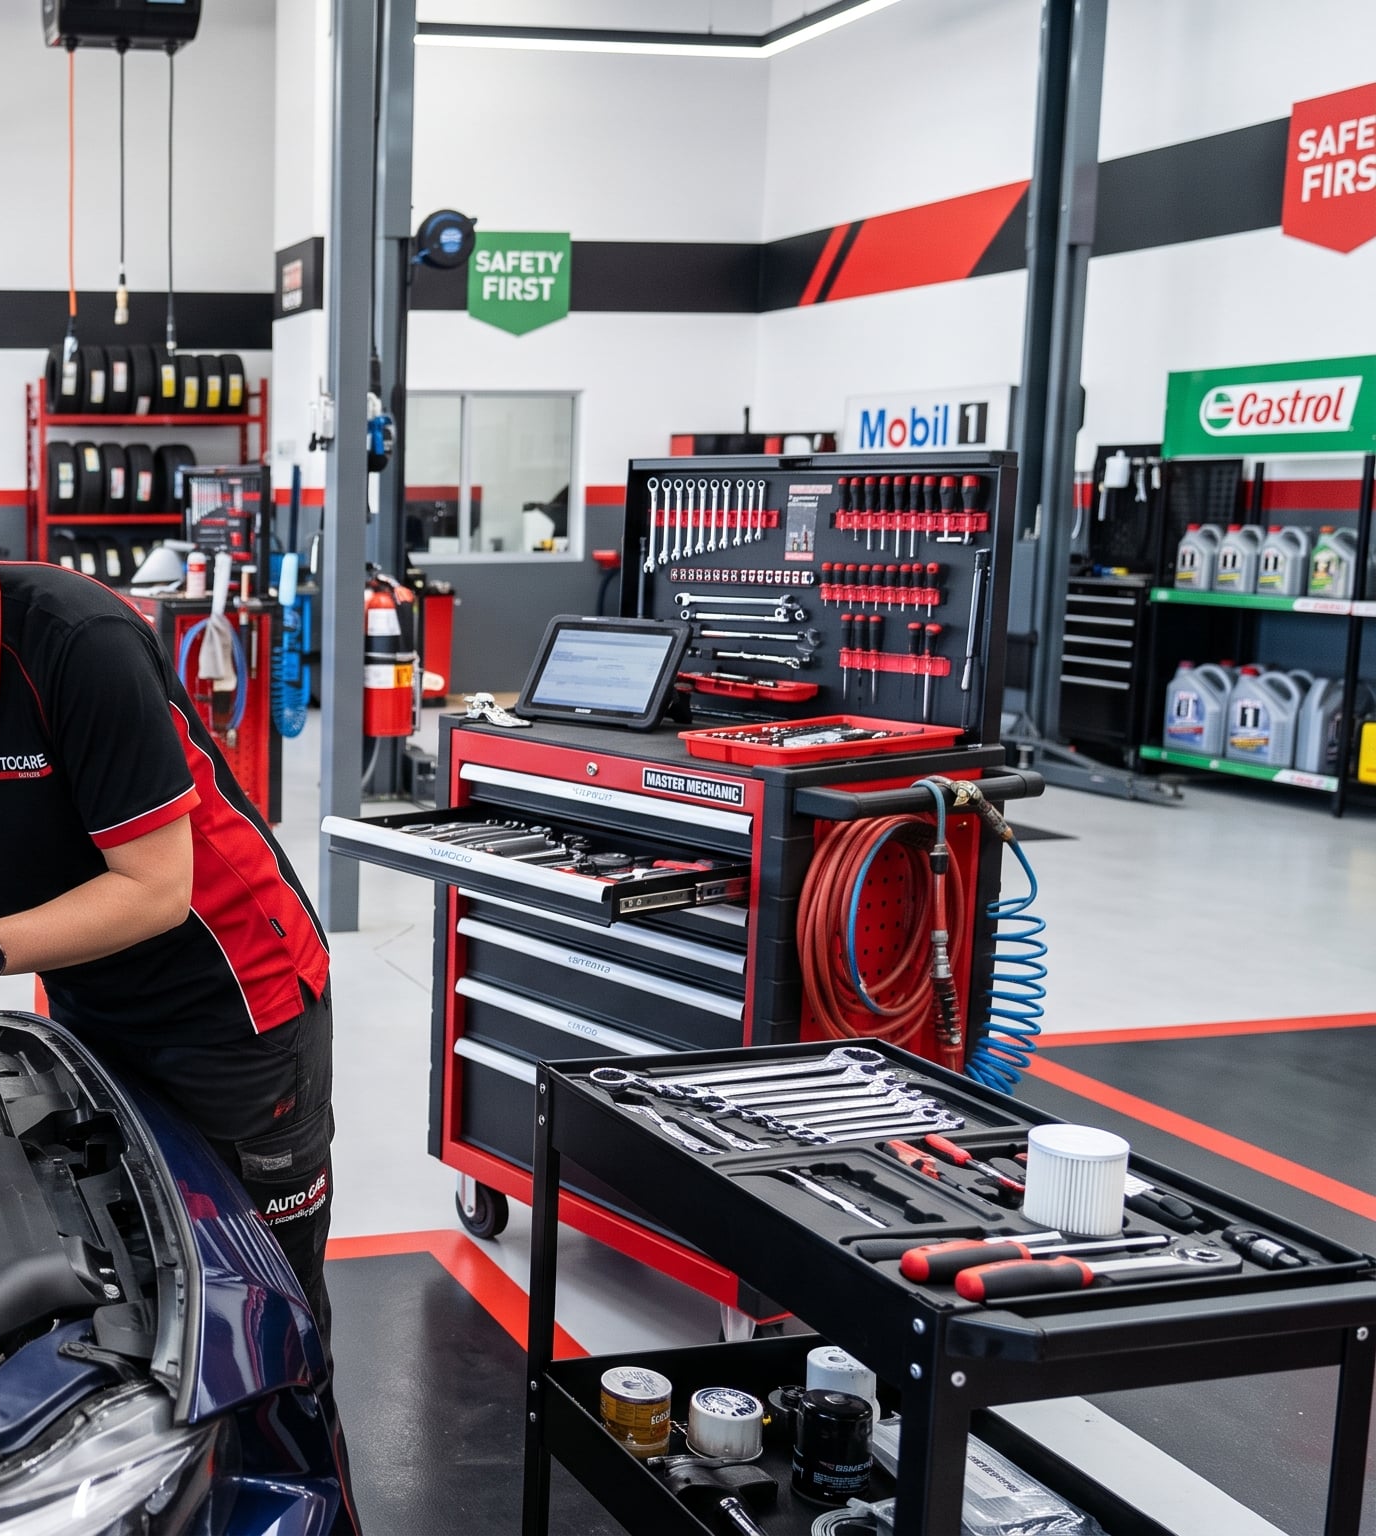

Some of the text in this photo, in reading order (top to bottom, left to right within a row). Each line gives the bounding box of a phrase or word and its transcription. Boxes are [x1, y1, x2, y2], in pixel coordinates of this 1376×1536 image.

[1297, 114, 1376, 162] SAFE
[1301, 154, 1376, 203] FIRS
[475, 250, 564, 274] SAFETY
[482, 275, 556, 301] FIRST
[1237, 386, 1346, 426] Castrol
[859, 402, 981, 449] Mobil 1
[646, 771, 739, 801] MASTER MECHANIC
[265, 1191, 306, 1214] AUTO
